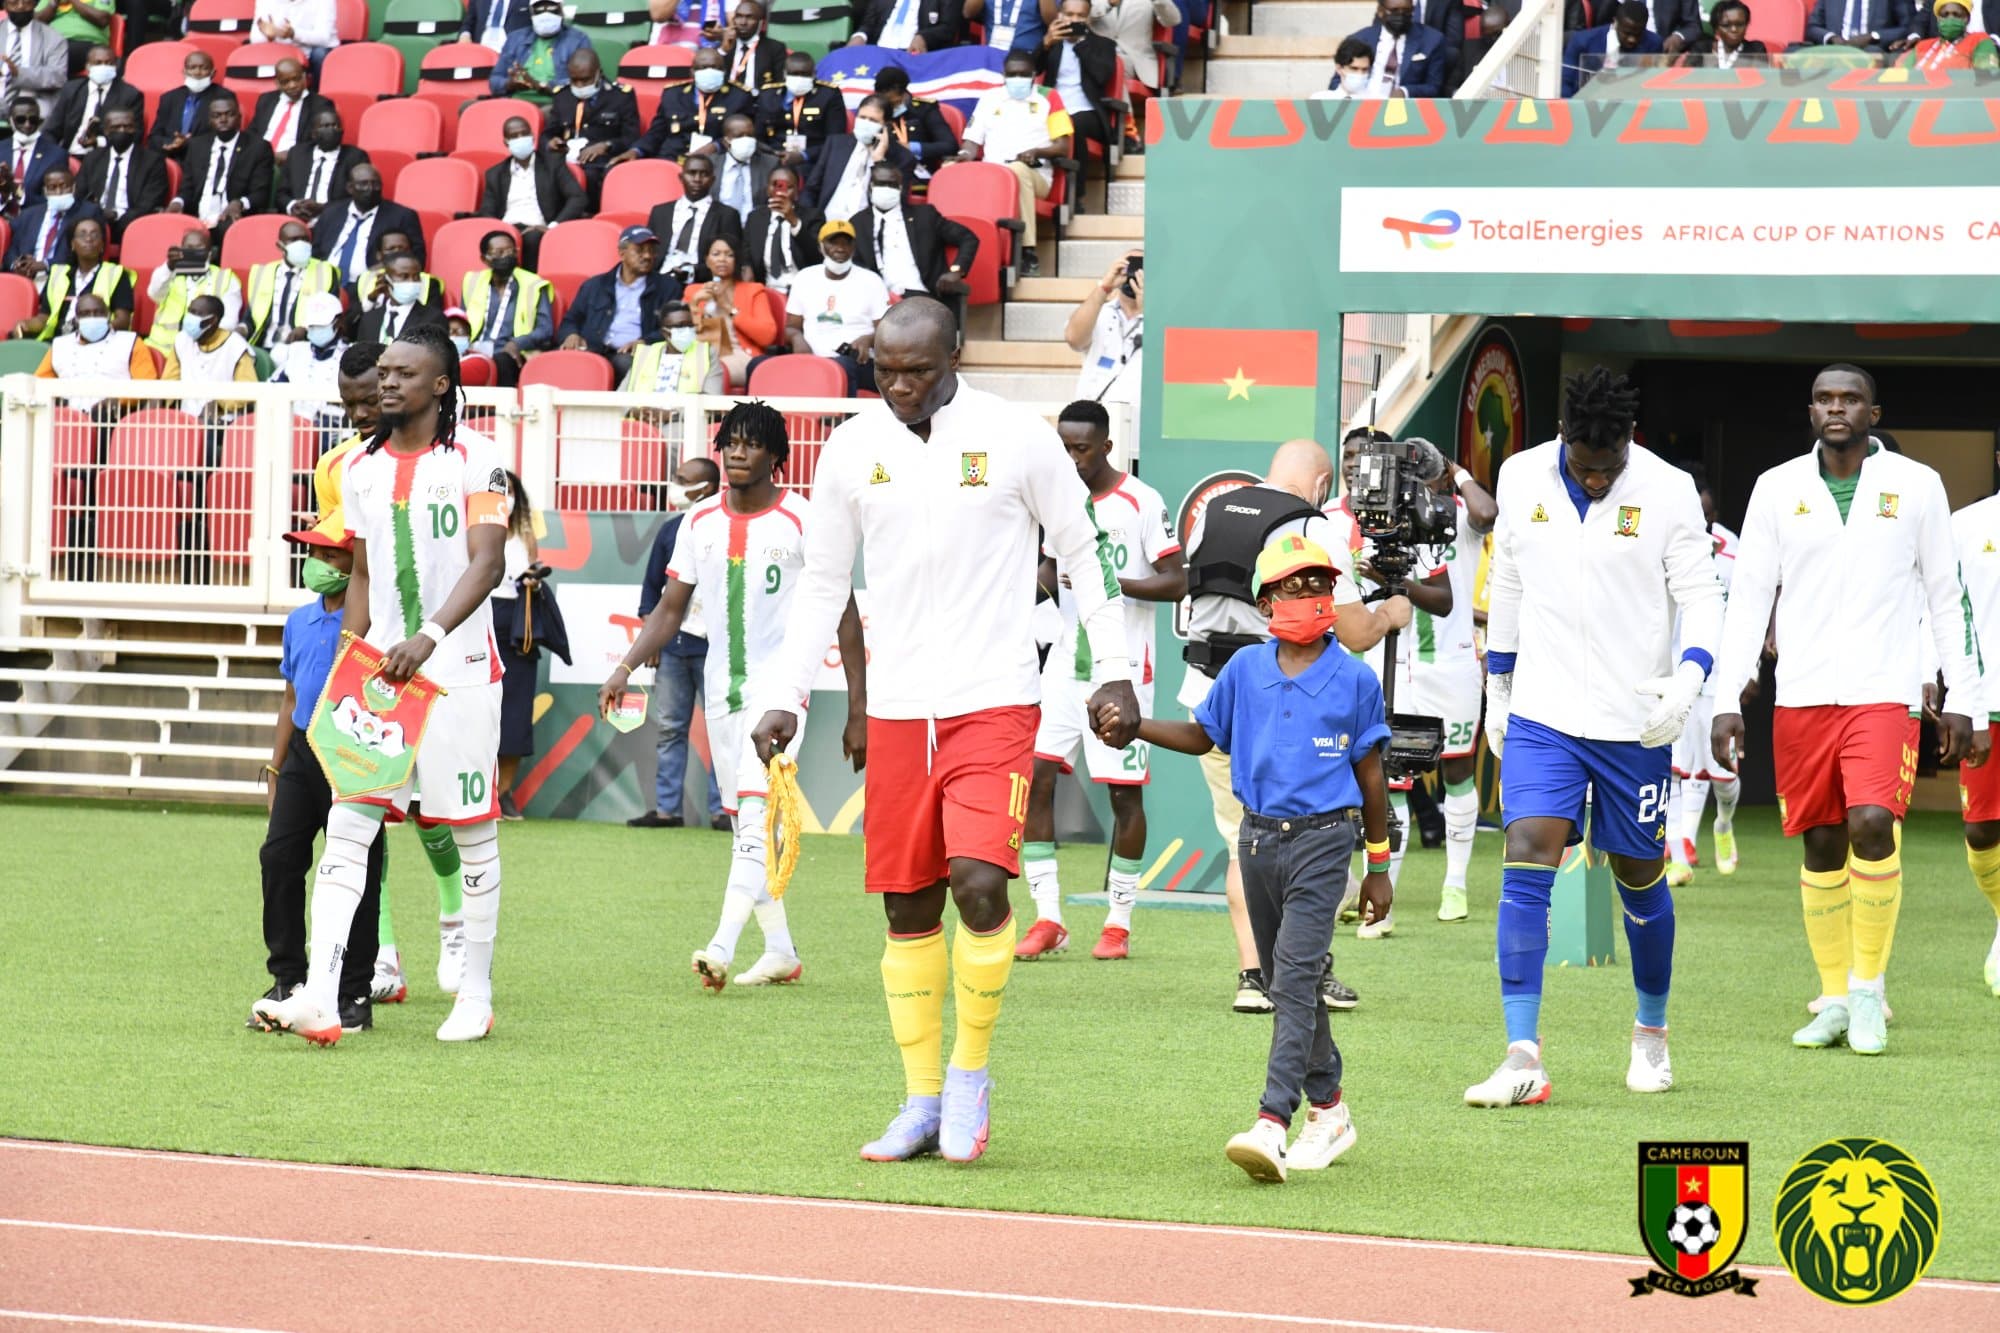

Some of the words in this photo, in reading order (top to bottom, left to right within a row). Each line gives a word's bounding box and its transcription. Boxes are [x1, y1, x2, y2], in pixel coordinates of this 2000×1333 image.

[1468, 219, 1643, 247] TotalEnergies
[1662, 225, 1745, 241] AFRICA
[1753, 225, 1798, 241] CUP
[1805, 225, 1836, 241] OF
[1844, 225, 1945, 241] NATIONS
[427, 503, 459, 539] 10
[765, 564, 781, 595] 9
[1311, 737, 1334, 748] VISA
[1448, 721, 1474, 746] 25
[1123, 744, 1147, 771] 20
[458, 770, 486, 806] 10
[1008, 772, 1029, 824] 10
[1638, 779, 1669, 822] 24
